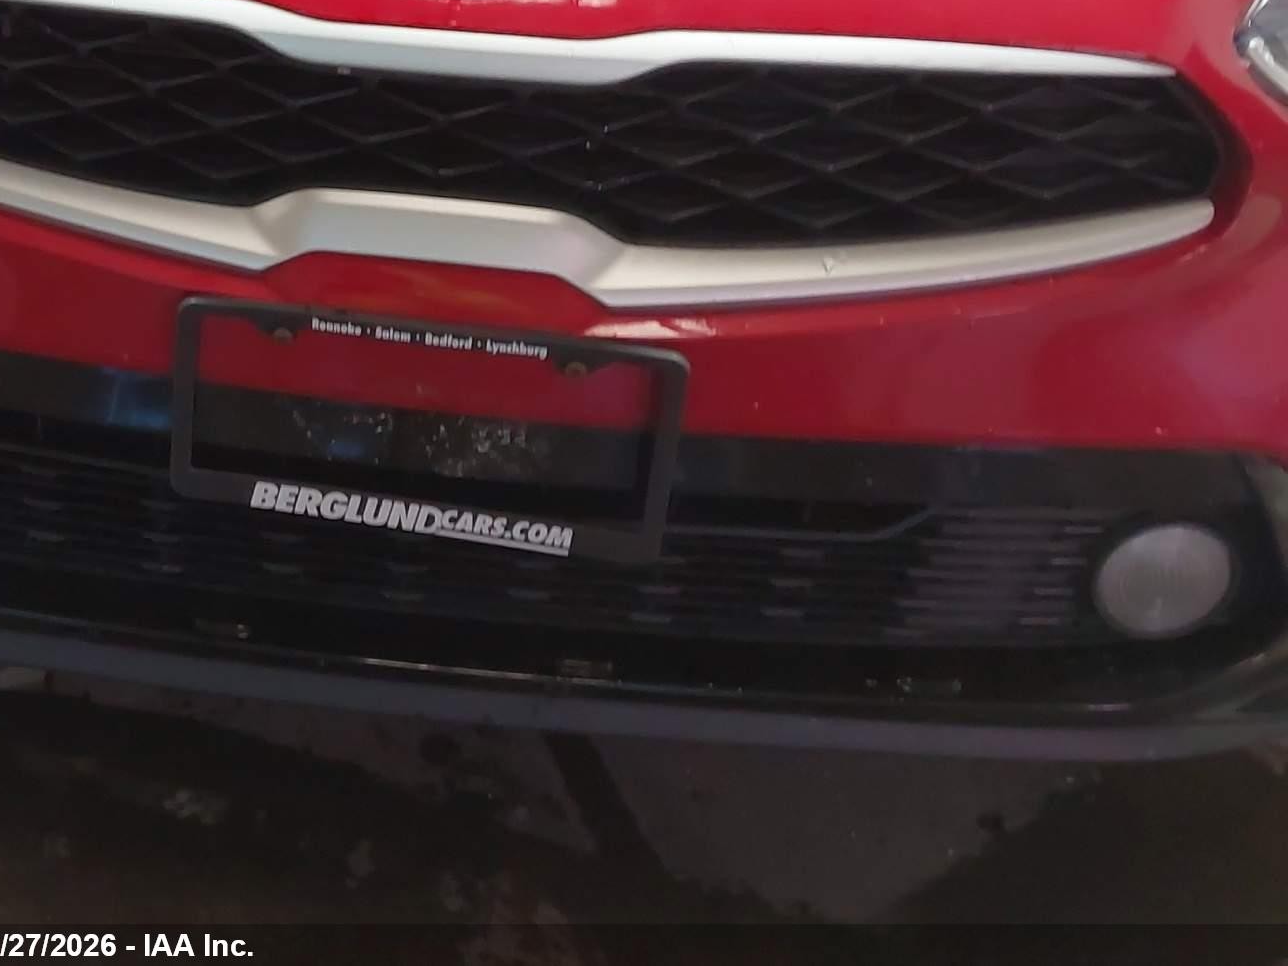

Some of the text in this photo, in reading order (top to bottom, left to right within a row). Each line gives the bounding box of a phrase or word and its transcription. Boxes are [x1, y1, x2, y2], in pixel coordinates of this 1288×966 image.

[375, 325, 411, 343] Salem
[424, 331, 473, 350] Bedford
[486, 338, 548, 360] Lynchburg
